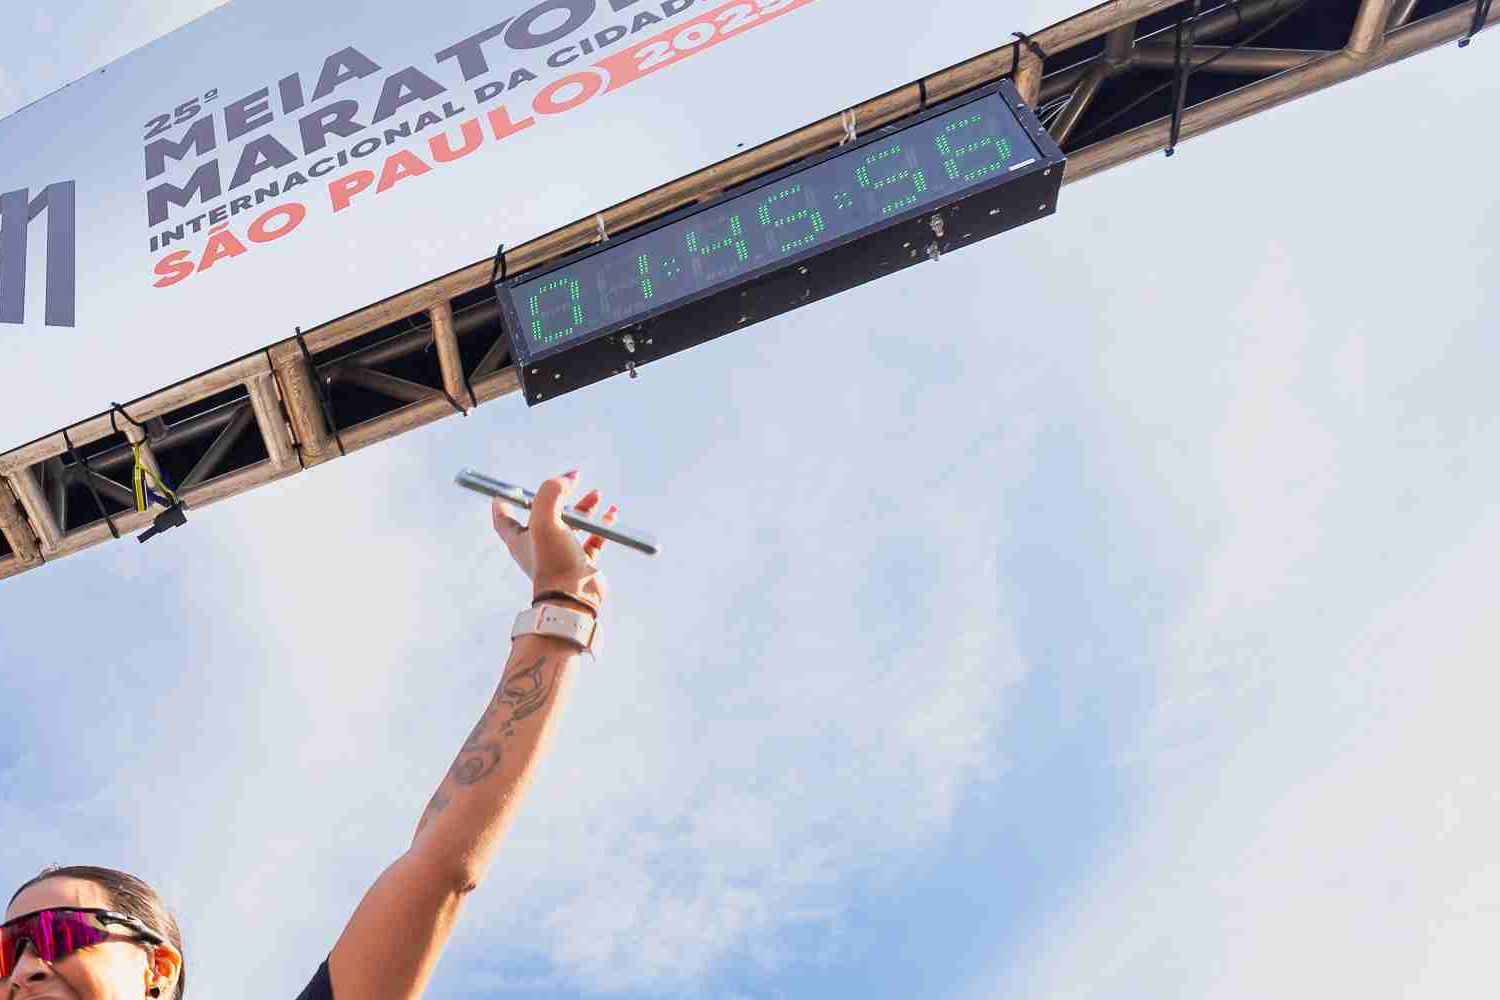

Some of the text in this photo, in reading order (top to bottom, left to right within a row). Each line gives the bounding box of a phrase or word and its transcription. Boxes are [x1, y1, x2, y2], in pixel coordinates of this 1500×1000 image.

[144, 46, 382, 181] MEIA
[146, 0, 644, 228] MARATO
[150, 0, 698, 252] INTERNACIONAL DA CIDAD
[152, 203, 306, 288] SÃO
[328, 71, 601, 213] PAULO
[531, 113, 1011, 343] 01:45:56
